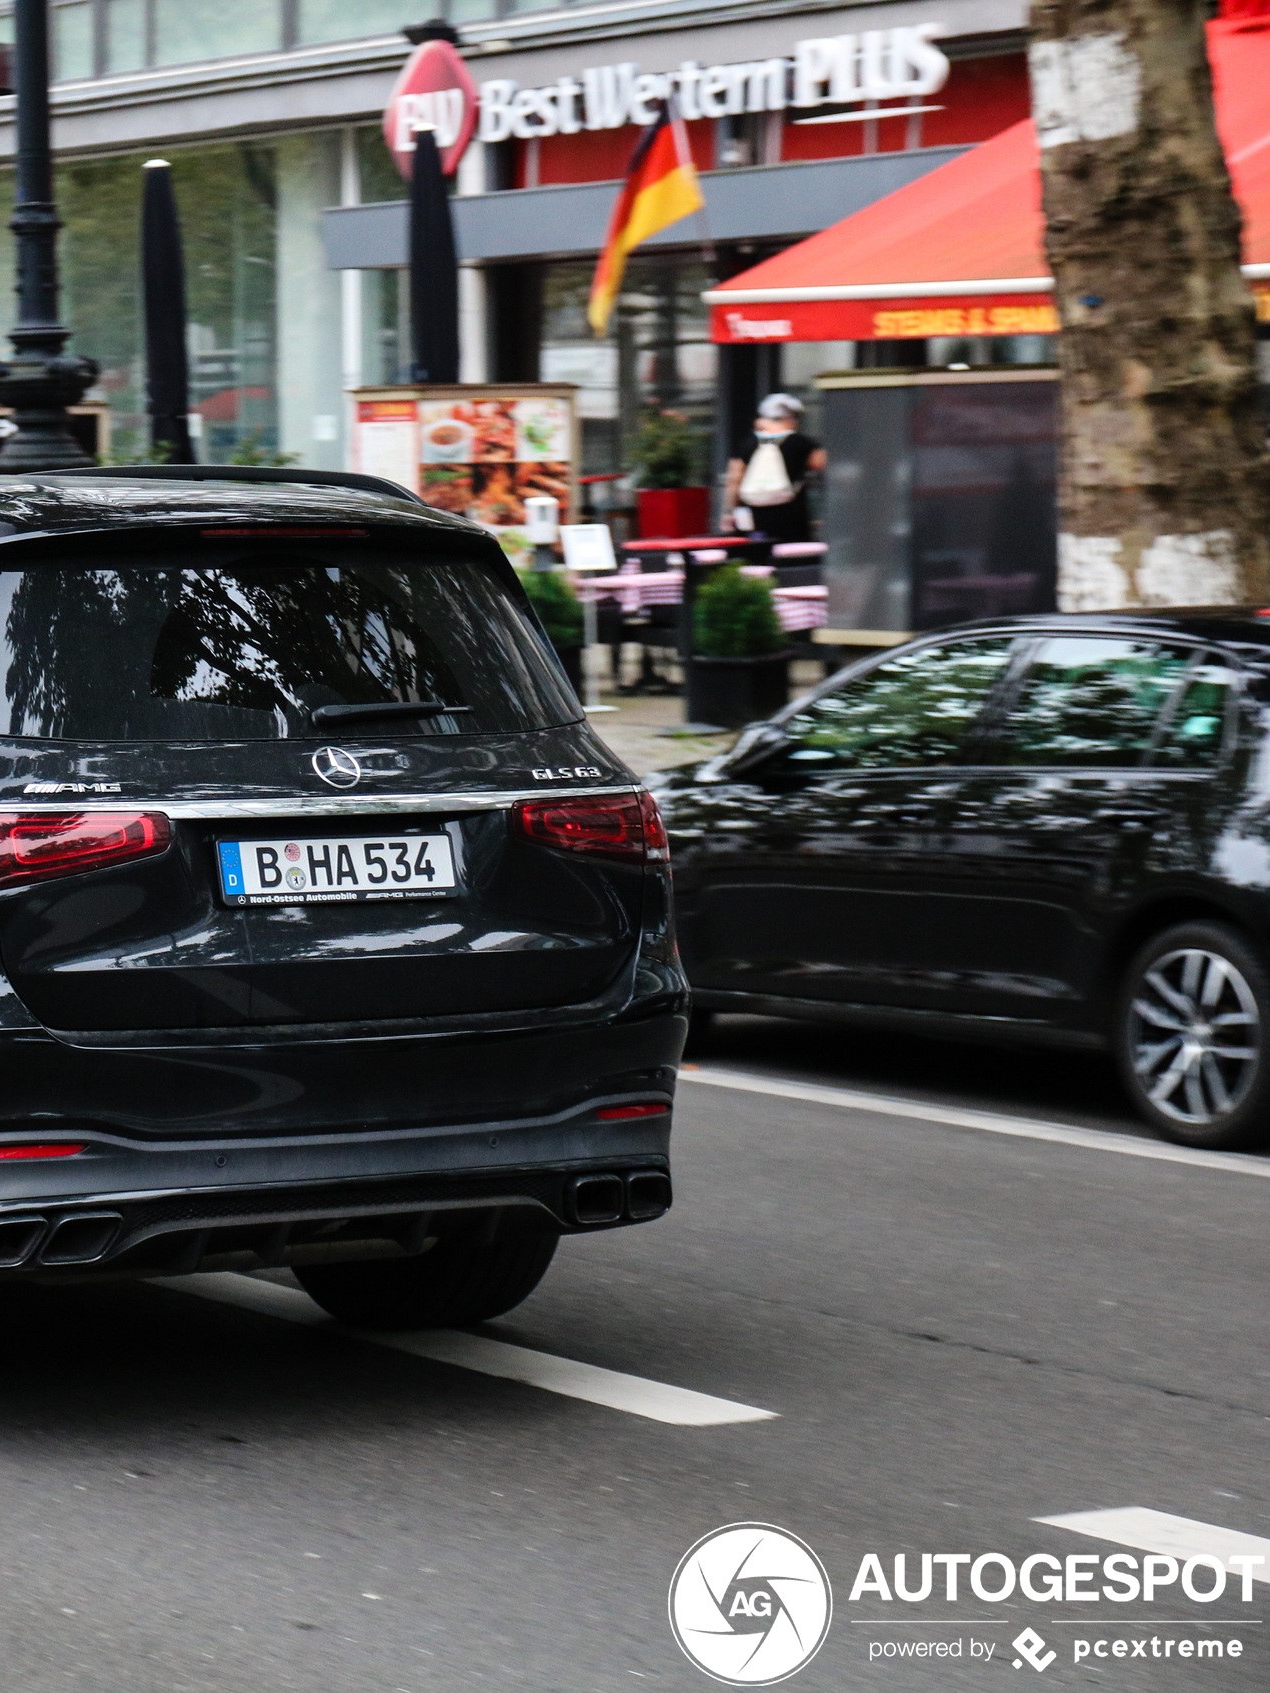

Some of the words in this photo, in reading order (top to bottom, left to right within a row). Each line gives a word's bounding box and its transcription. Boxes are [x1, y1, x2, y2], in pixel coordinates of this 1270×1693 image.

[478, 79, 582, 143] Best
[792, 22, 950, 106] PLUS
[532, 767, 573, 780] GLS
[574, 766, 602, 778] 63
[54, 783, 121, 793] AMG
[255, 846, 283, 888] B
[228, 874, 238, 886] D
[249, 894, 304, 904] Nord-Ostsee
[306, 892, 358, 902] Automobile
[405, 890, 431, 898] Performance
